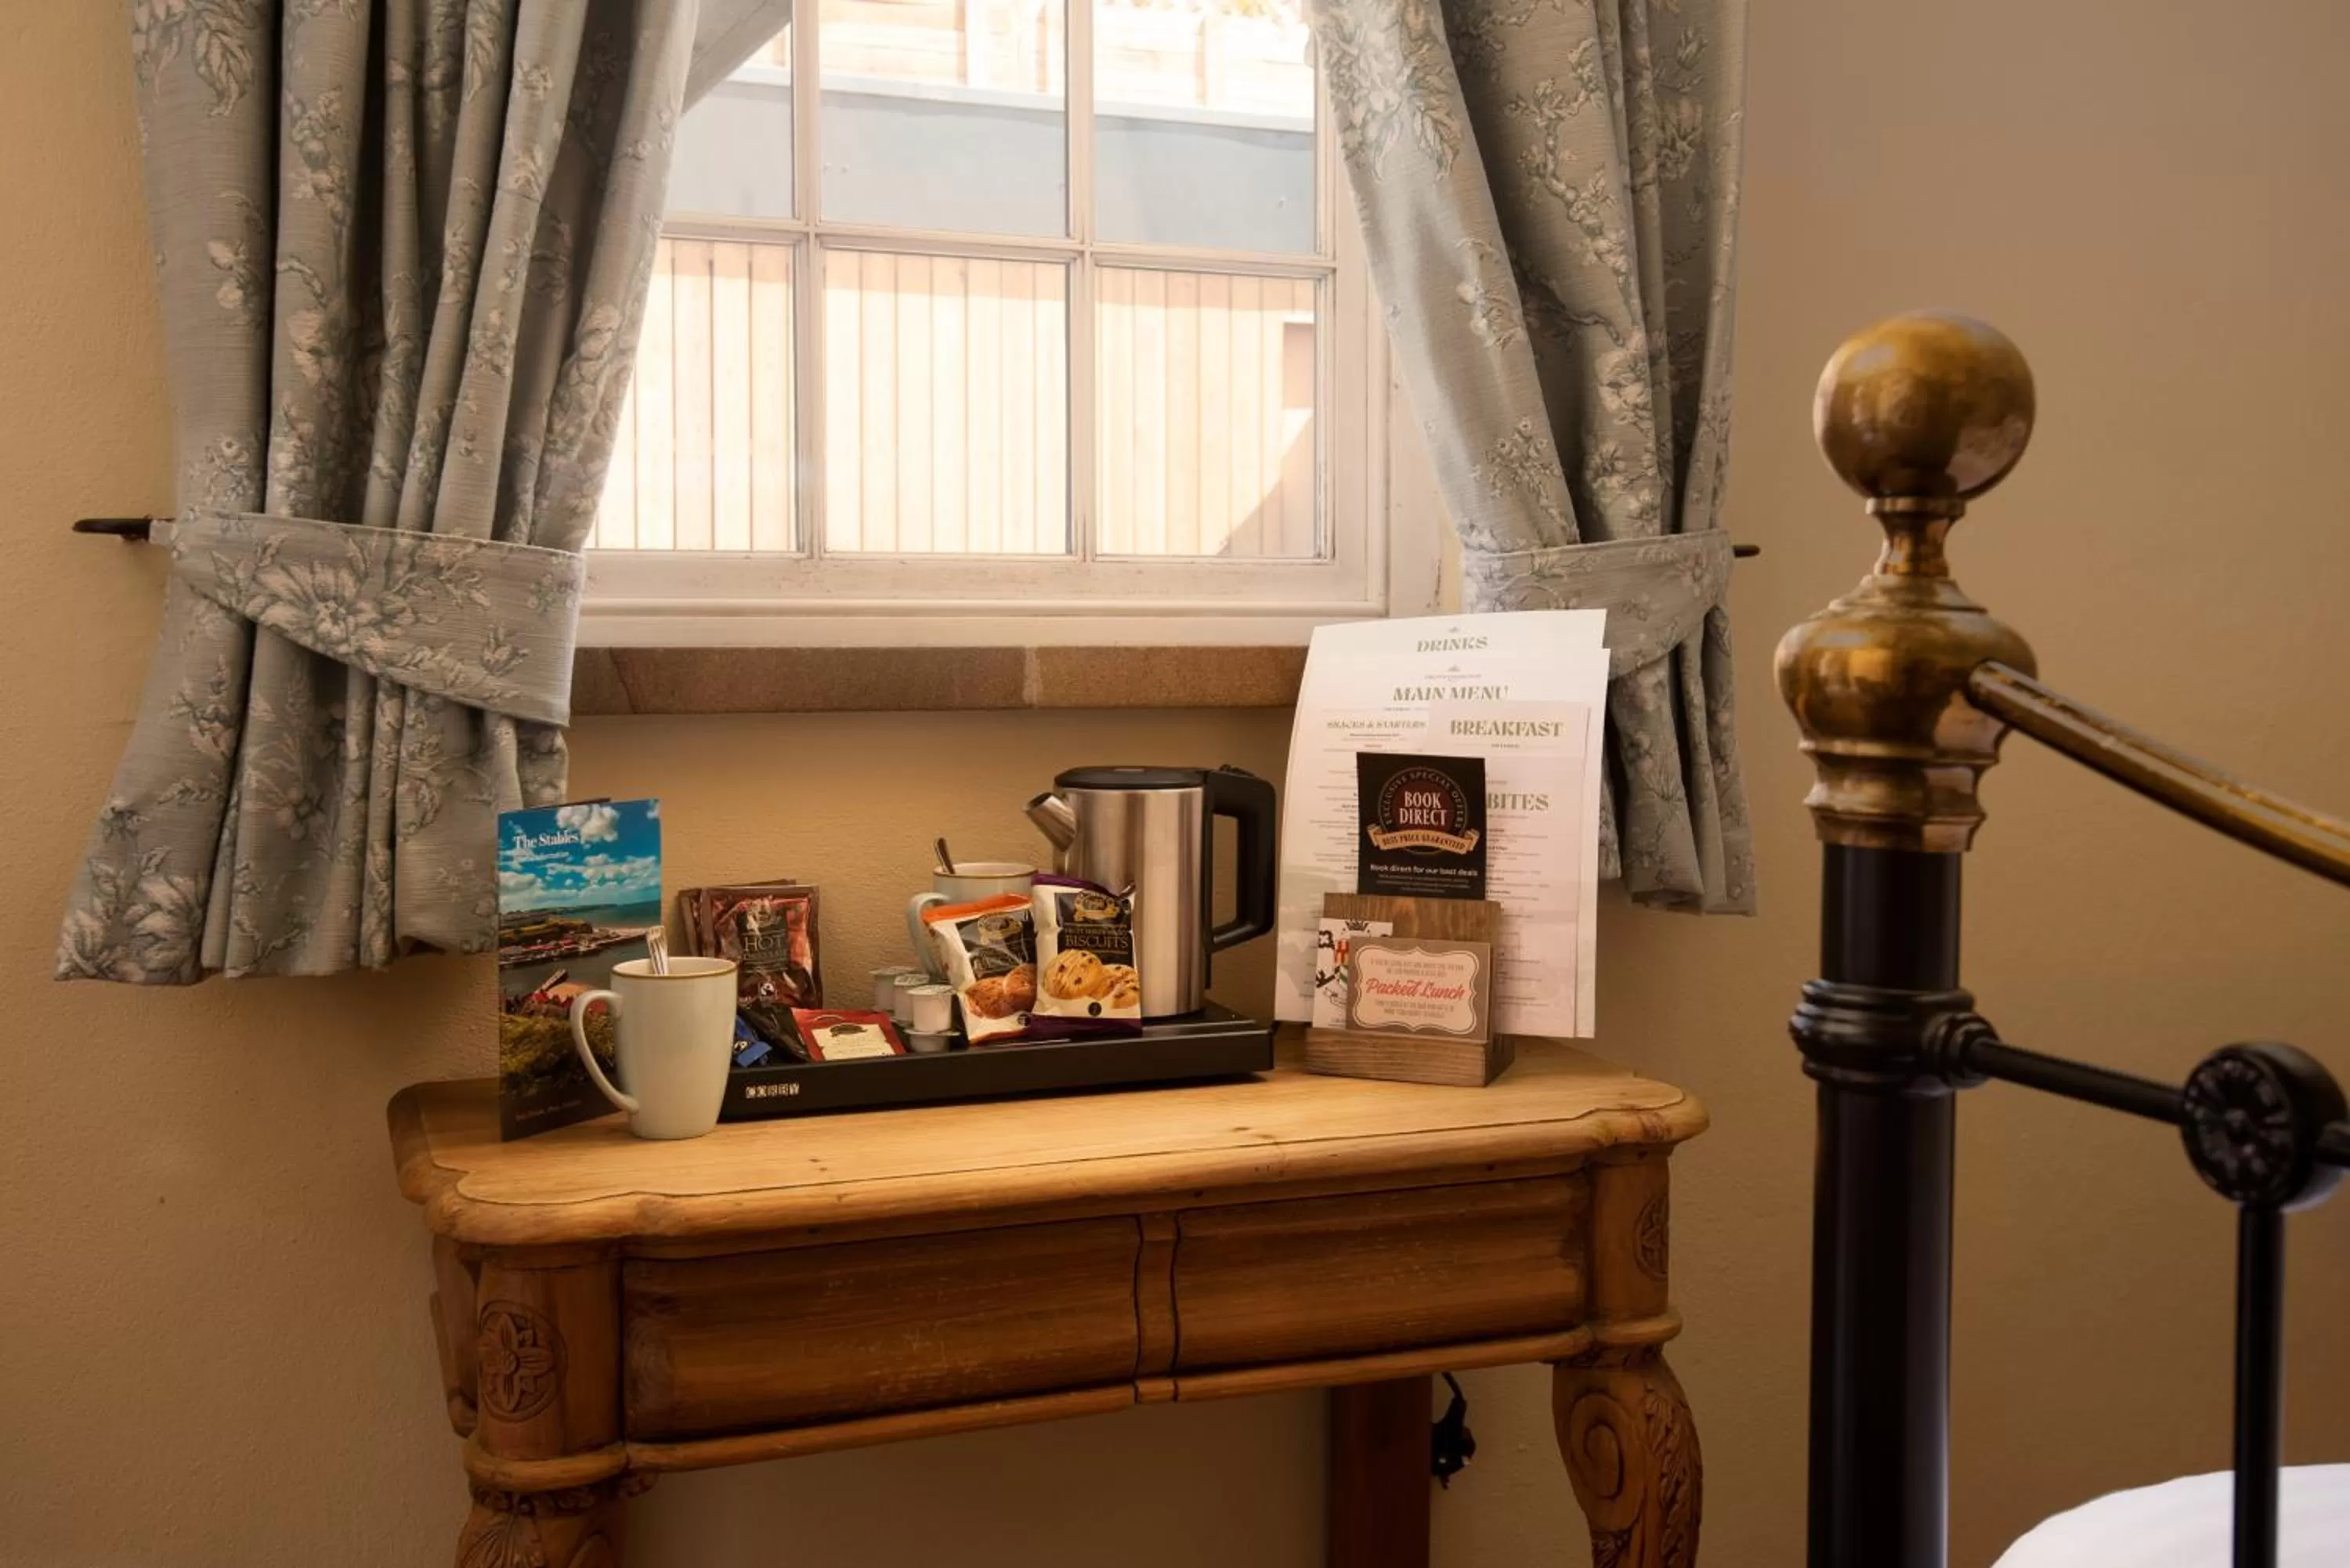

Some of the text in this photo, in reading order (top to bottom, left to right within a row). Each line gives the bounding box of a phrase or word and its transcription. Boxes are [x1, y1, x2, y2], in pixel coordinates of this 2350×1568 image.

[1417, 636, 1488, 652] DRINKS
[1393, 685, 1509, 702] MAIN MENU
[1450, 720, 1564, 737] BREAKFAST
[1410, 771, 1451, 790] SPECIAL
[1405, 790, 1442, 809] BOOK
[1488, 793, 1549, 811] BITES
[1399, 807, 1448, 826] DIRECT
[512, 830, 579, 849] The Stables
[1400, 833, 1419, 844] PRICE
[1413, 865, 1424, 874] for
[743, 935, 782, 951] HOT
[1065, 934, 1129, 948] BISCUITS
[1365, 977, 1466, 999] Packed Lunch
